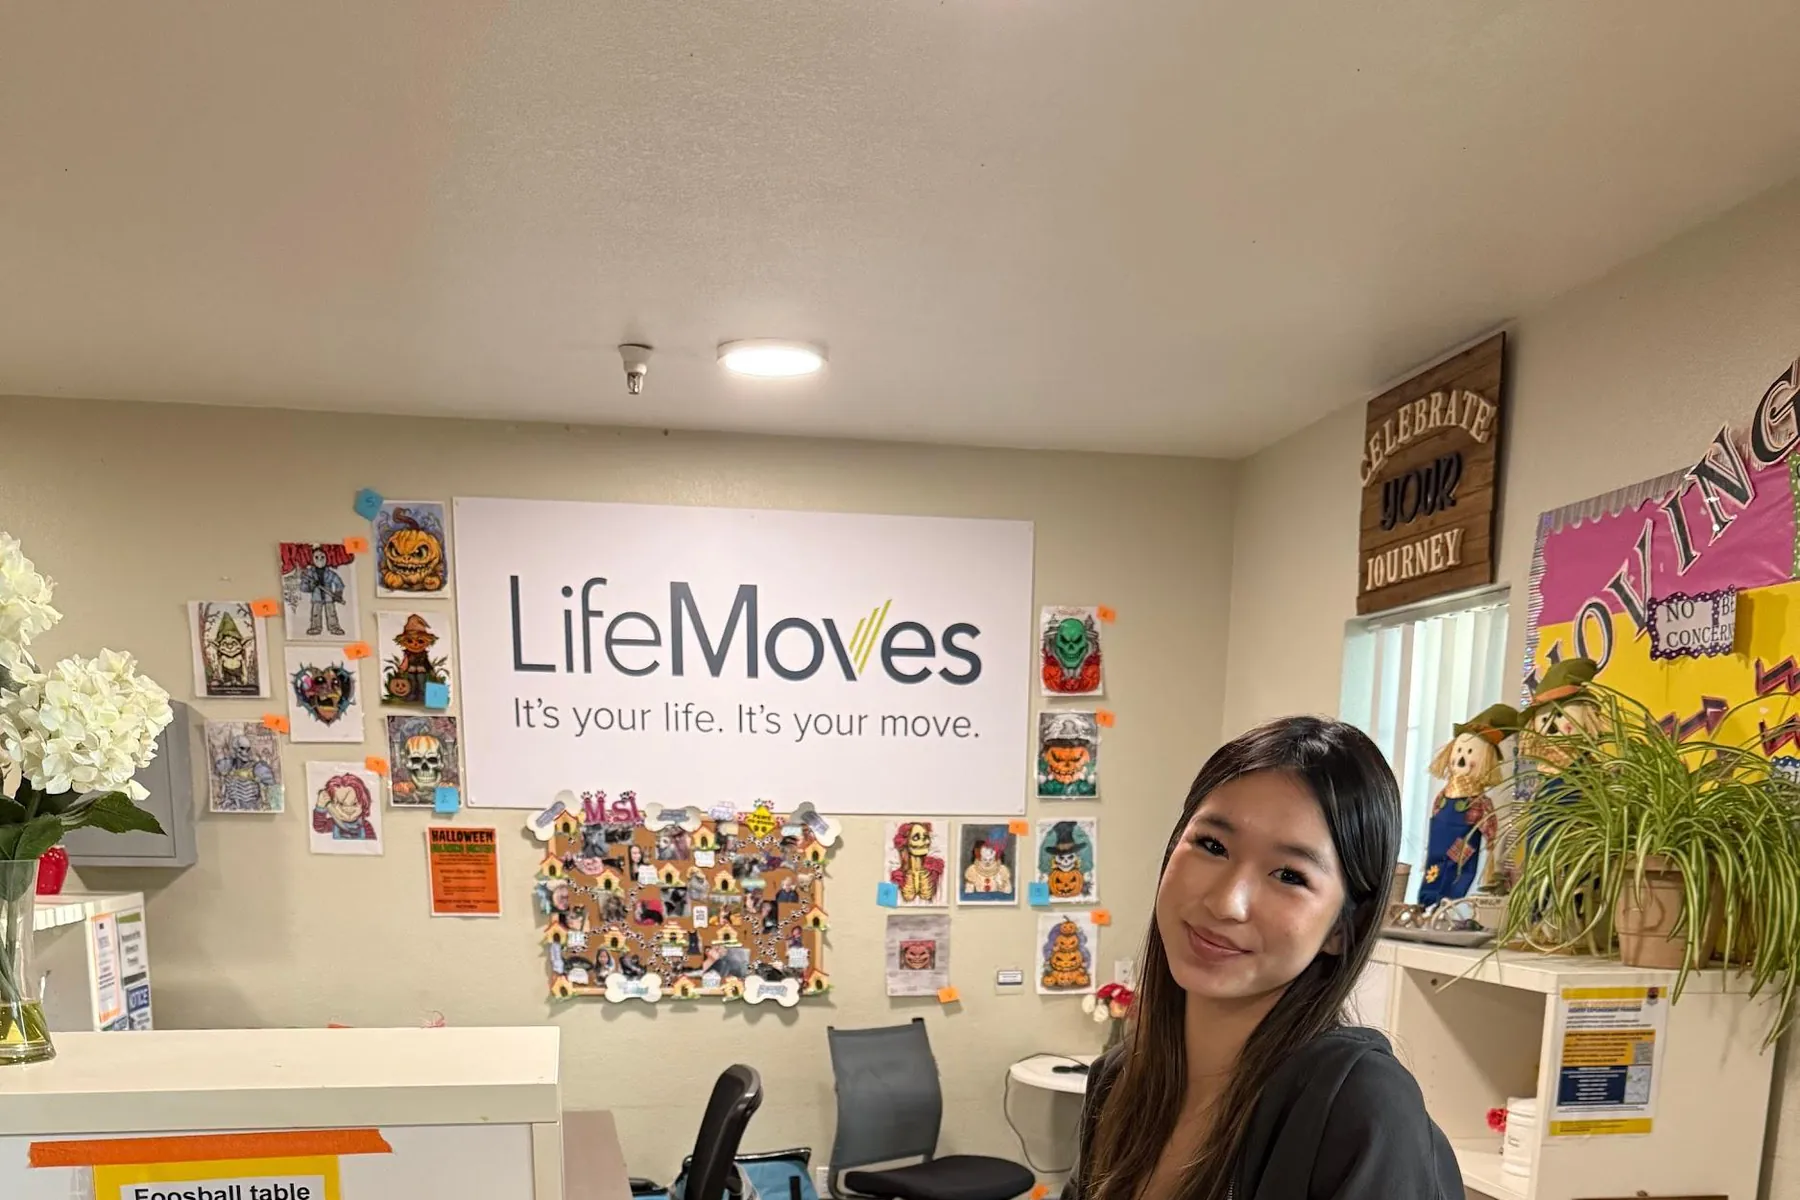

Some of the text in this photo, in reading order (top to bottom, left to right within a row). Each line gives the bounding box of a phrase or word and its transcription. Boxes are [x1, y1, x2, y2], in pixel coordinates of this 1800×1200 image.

[1359, 390, 1496, 487] CELEBRATE
[1380, 451, 1462, 531] YOUR
[1365, 528, 1464, 592] JOURNEY
[510, 575, 982, 685] LifeMoves
[1667, 601, 1695, 622] NO
[514, 697, 981, 743] It's your life. It's your move.
[431, 830, 493, 843] HALLOWEEN
